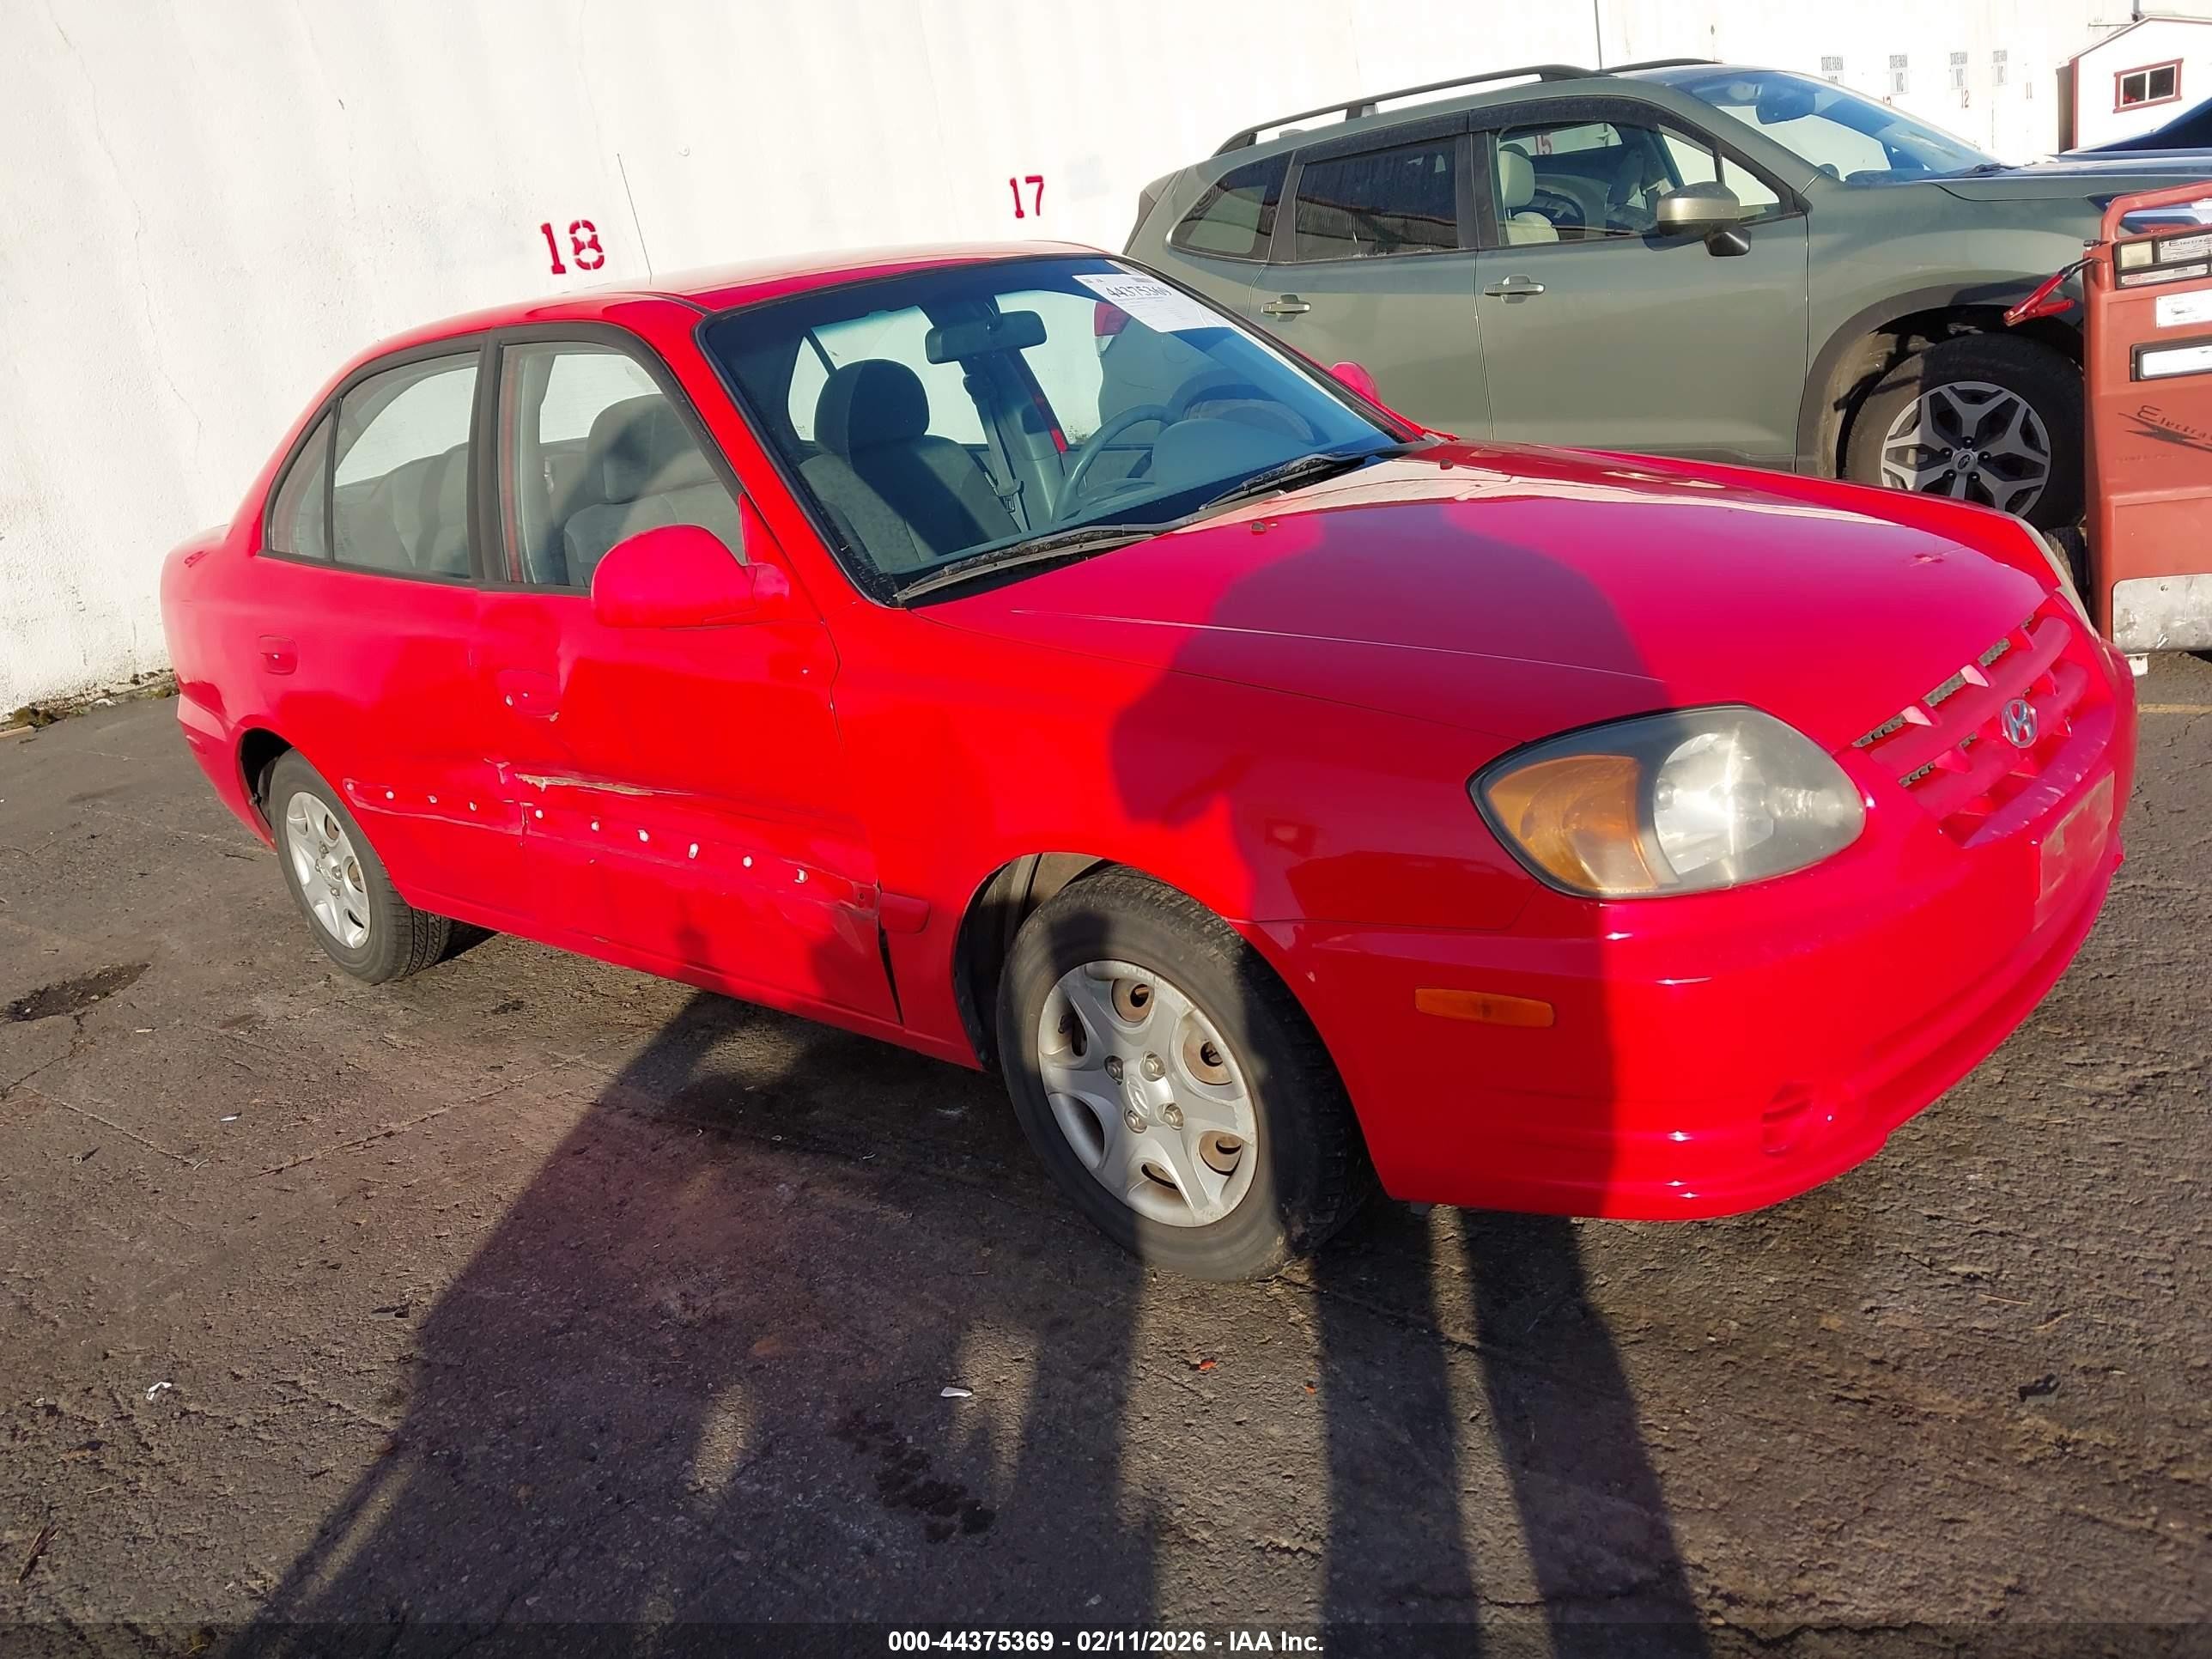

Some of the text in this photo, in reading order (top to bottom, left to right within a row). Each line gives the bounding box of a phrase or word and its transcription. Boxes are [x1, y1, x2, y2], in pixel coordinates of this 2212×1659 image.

[1820, 56, 1844, 70] STATE FARM
[1961, 88, 1970, 108] 12
[1010, 175, 1044, 218] 17
[540, 220, 605, 275] 18
[1106, 286, 1172, 297] 44375369
[2137, 404, 2212, 441] Electra
